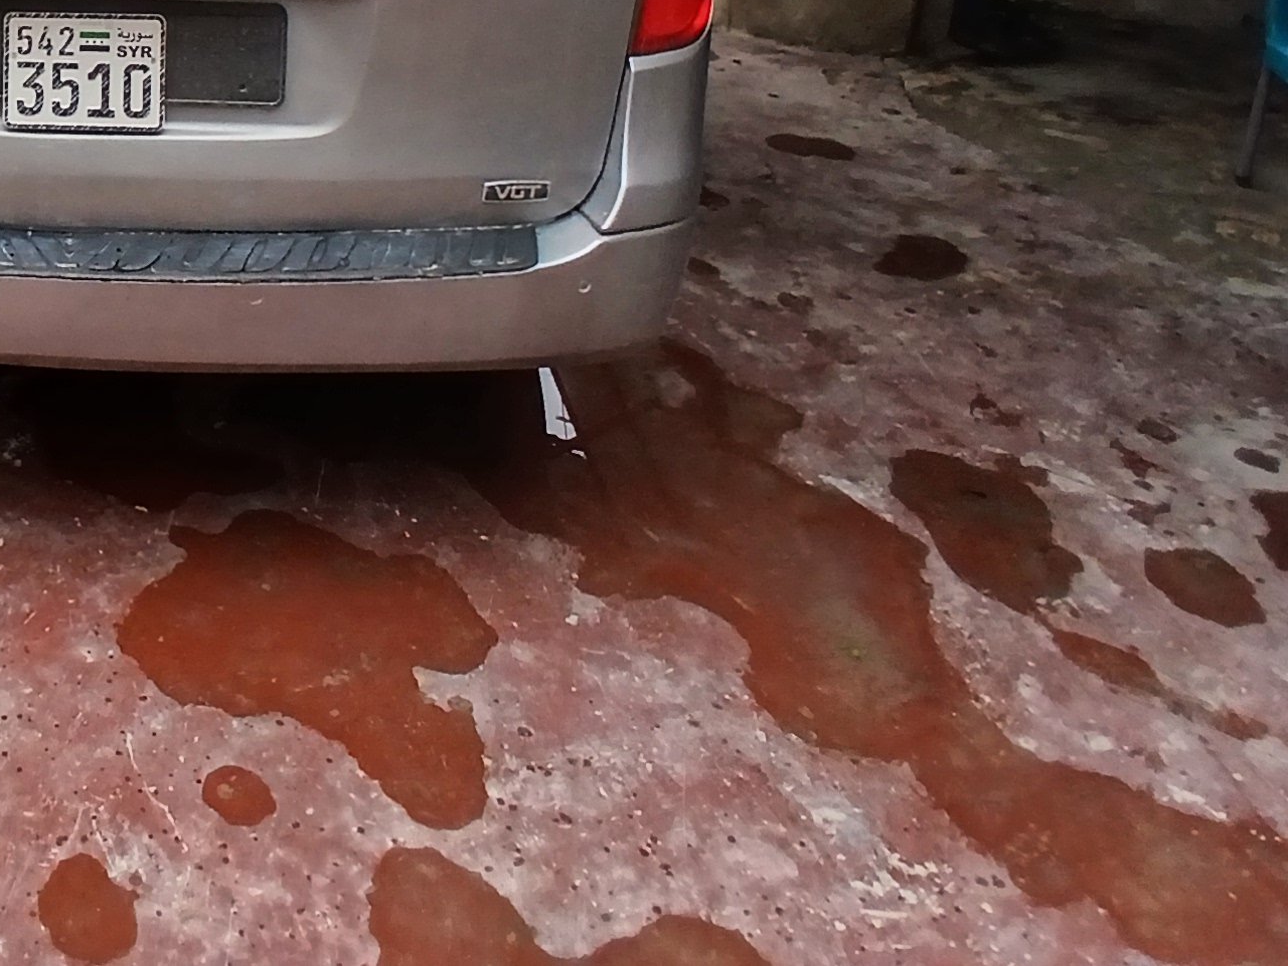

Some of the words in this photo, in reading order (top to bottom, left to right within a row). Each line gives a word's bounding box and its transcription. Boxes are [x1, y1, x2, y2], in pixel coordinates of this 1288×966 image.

[16, 25, 75, 57] 542
[116, 27, 155, 44] سورية
[116, 45, 153, 59] SYR
[16, 60, 153, 119] 3510
[494, 184, 542, 200] VGT
